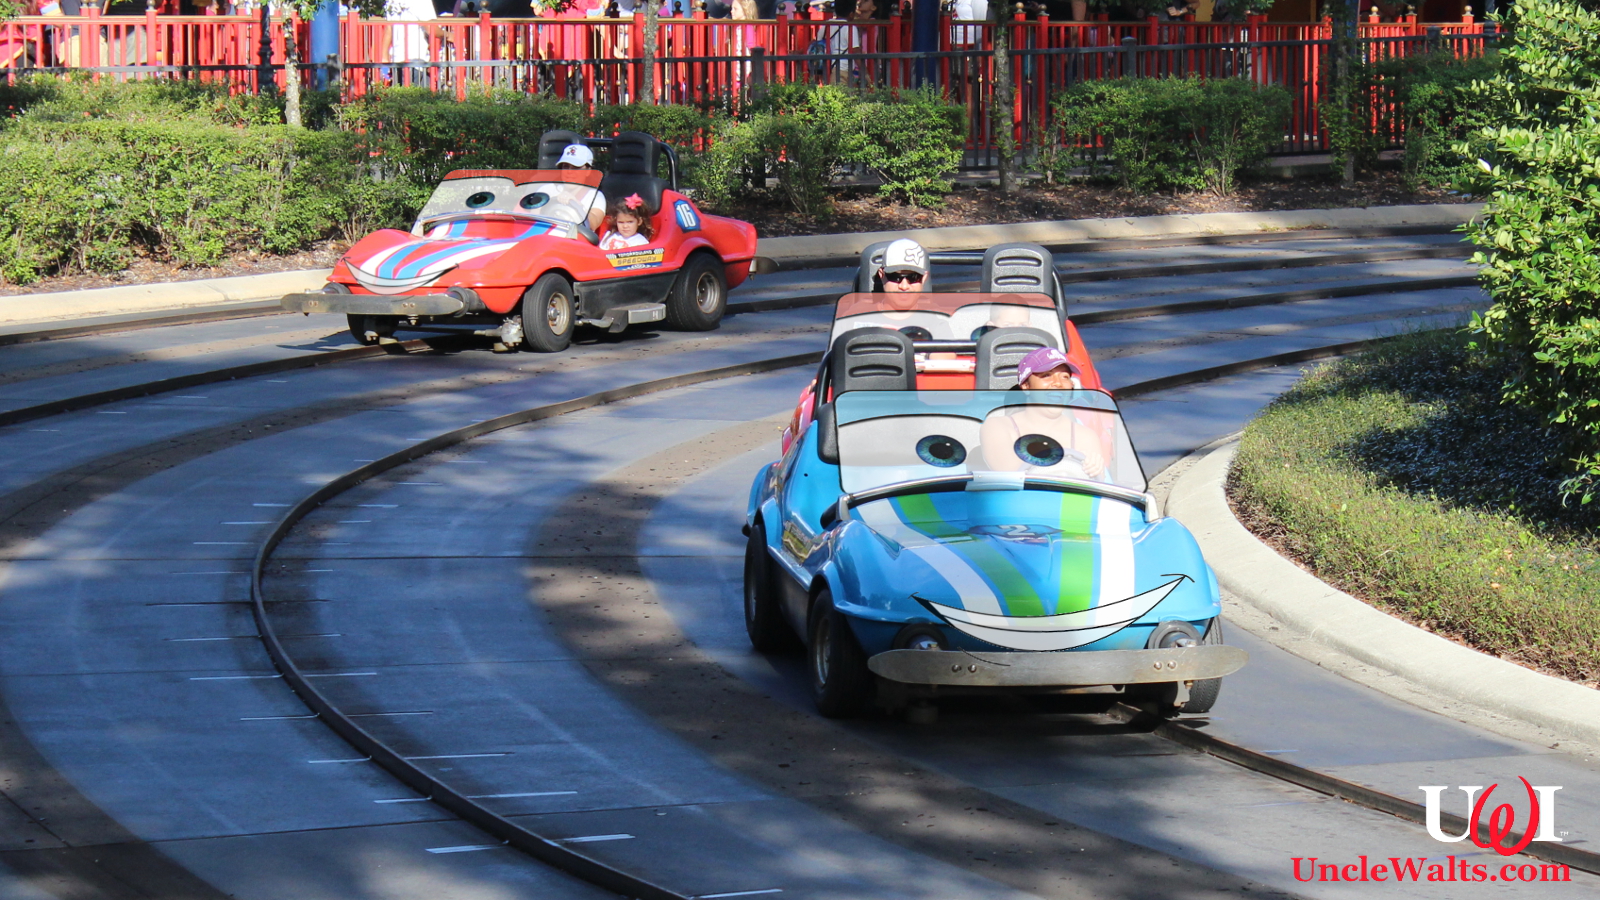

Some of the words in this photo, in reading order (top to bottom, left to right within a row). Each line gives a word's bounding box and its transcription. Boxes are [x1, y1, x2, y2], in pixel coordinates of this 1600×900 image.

[676, 203, 696, 227] 16
[617, 255, 657, 265] SPEEDWAY
[998, 525, 1036, 536] 2
